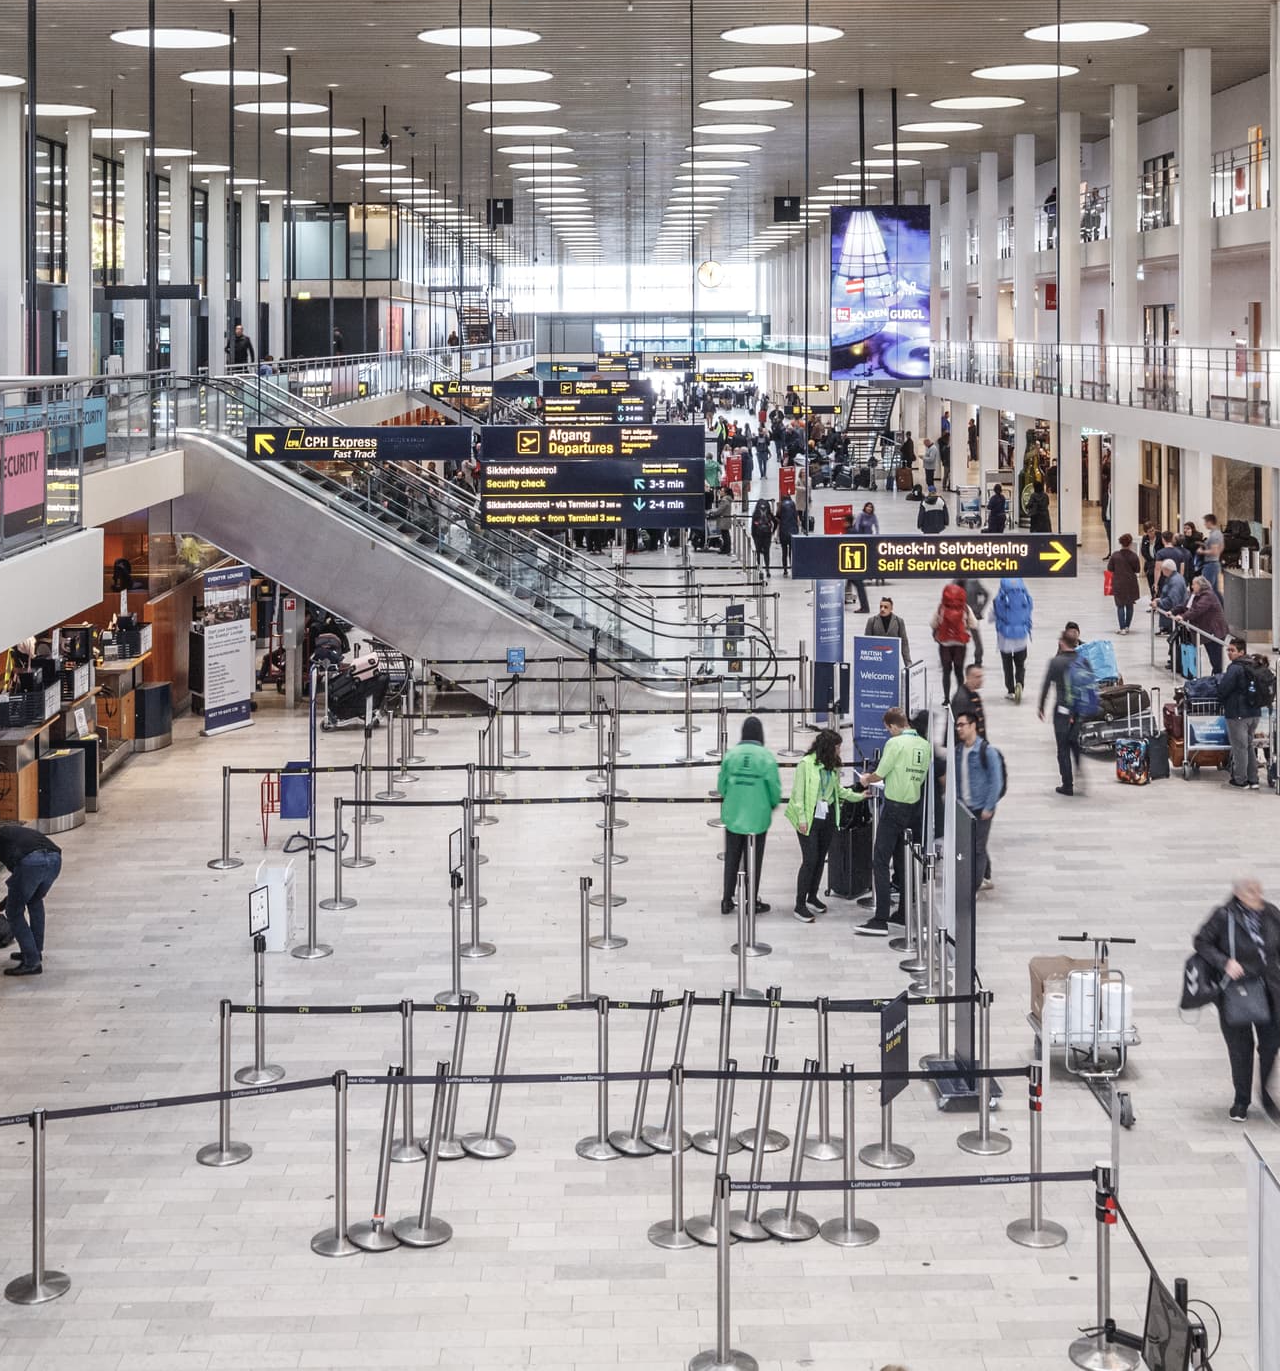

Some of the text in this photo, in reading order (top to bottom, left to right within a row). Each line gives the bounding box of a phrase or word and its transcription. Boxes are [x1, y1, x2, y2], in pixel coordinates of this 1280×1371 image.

[890, 309, 924, 319] GURGL
[548, 429, 590, 442] Afgang
[304, 436, 377, 449] CPH Express
[333, 450, 376, 458] Fast Track
[548, 443, 614, 456] Departures
[486, 466, 557, 475] Sikkerhedskontrol
[486, 480, 546, 489] Security check
[649, 480, 684, 488] 3-5 min
[486, 501, 550, 509] Sikkerhedskontrol
[555, 501, 567, 509] via
[649, 500, 684, 509] 2-4 min
[486, 514, 517, 523] Security
[518, 514, 540, 522] check
[548, 514, 565, 522] from
[568, 514, 598, 522] Terminal
[600, 514, 605, 522] 3
[878, 542, 1028, 557] Check-in Selvbetjening
[878, 558, 1018, 571] Self Service Check-in
[860, 671, 895, 681] Welcome
[472, 1076, 490, 1084] Group
[231, 1086, 277, 1097] Lufthansa Group
[139, 1100, 158, 1108] Group
[979, 1175, 1009, 1183] Lufthansa
[752, 1182, 771, 1190] Group
